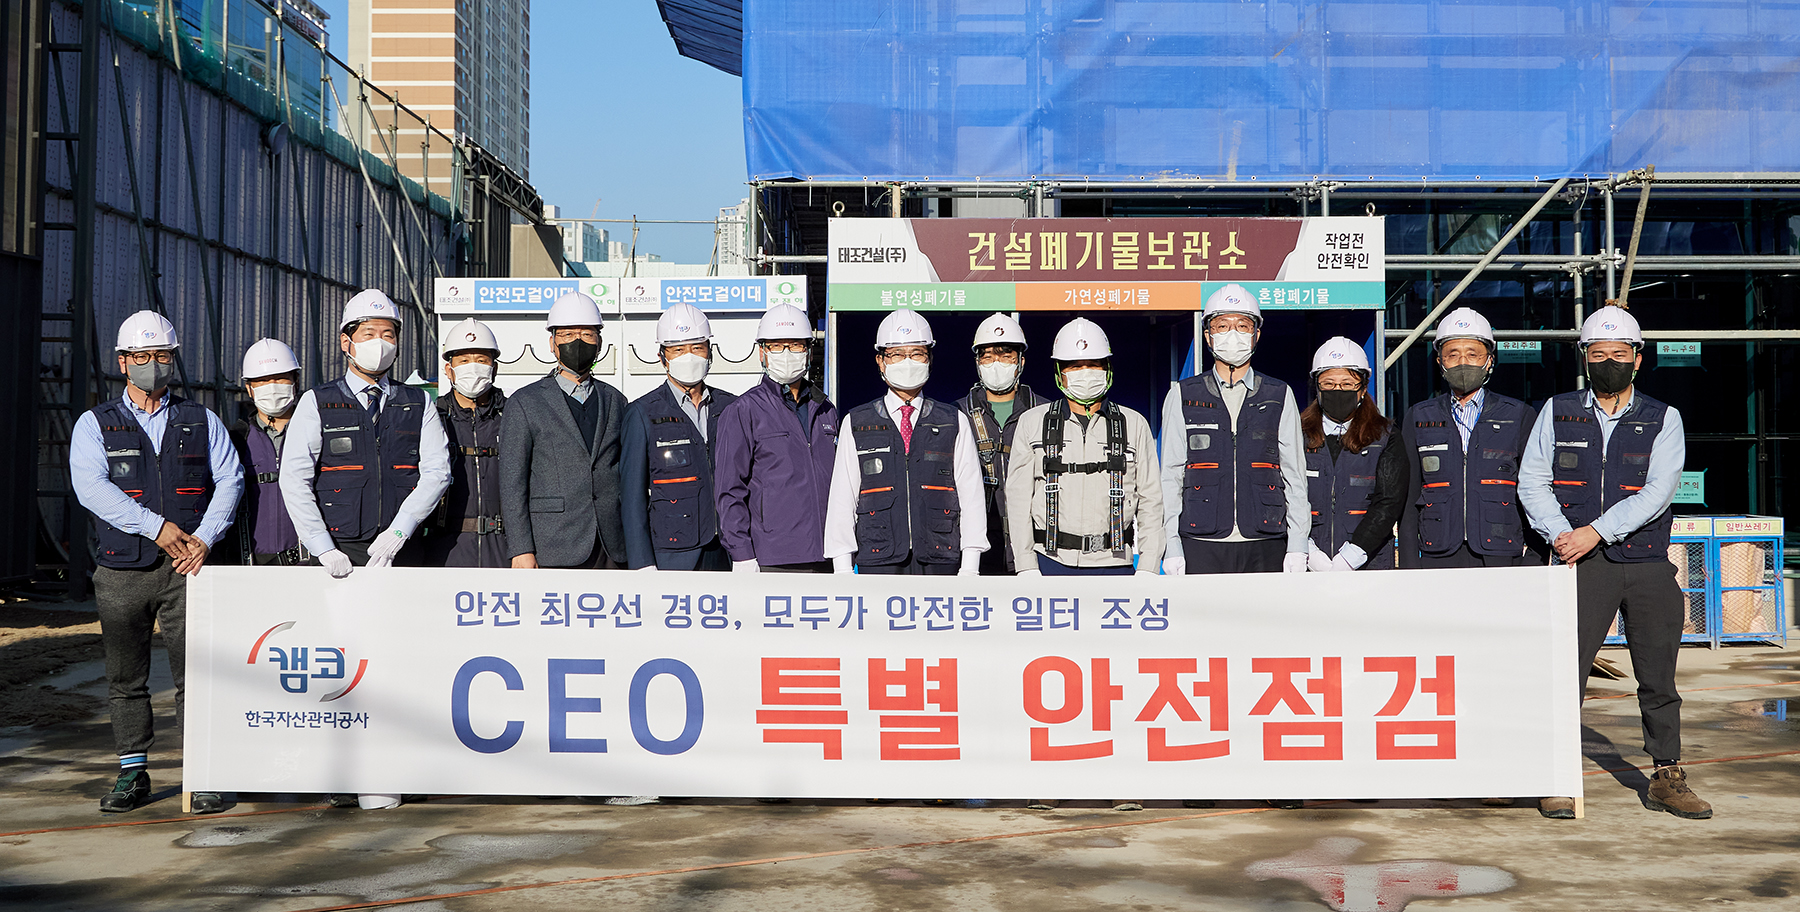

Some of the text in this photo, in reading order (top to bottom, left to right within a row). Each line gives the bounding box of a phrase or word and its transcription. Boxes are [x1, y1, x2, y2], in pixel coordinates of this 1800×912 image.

[1325, 233, 1364, 249] 작업전
[838, 247, 907, 263] 태조건설(주)
[968, 231, 1247, 271] 건설폐기물보관소
[1317, 252, 1369, 270] 안전확인
[665, 285, 762, 303] 안전모걸이대
[880, 289, 967, 306] 불연성폐기물
[1064, 288, 1150, 305] 가연성폐기물
[1258, 288, 1330, 305] 혼합폐기물
[1725, 522, 1771, 532] 일반쓰레기
[455, 590, 1170, 632] 안전 최우선 경영, 모두가 안전한 일터 조성
[268, 646, 346, 693] 캠코
[451, 655, 1457, 762] CEO 특별 안전점검
[244, 710, 370, 729] 한국자산관리공사
